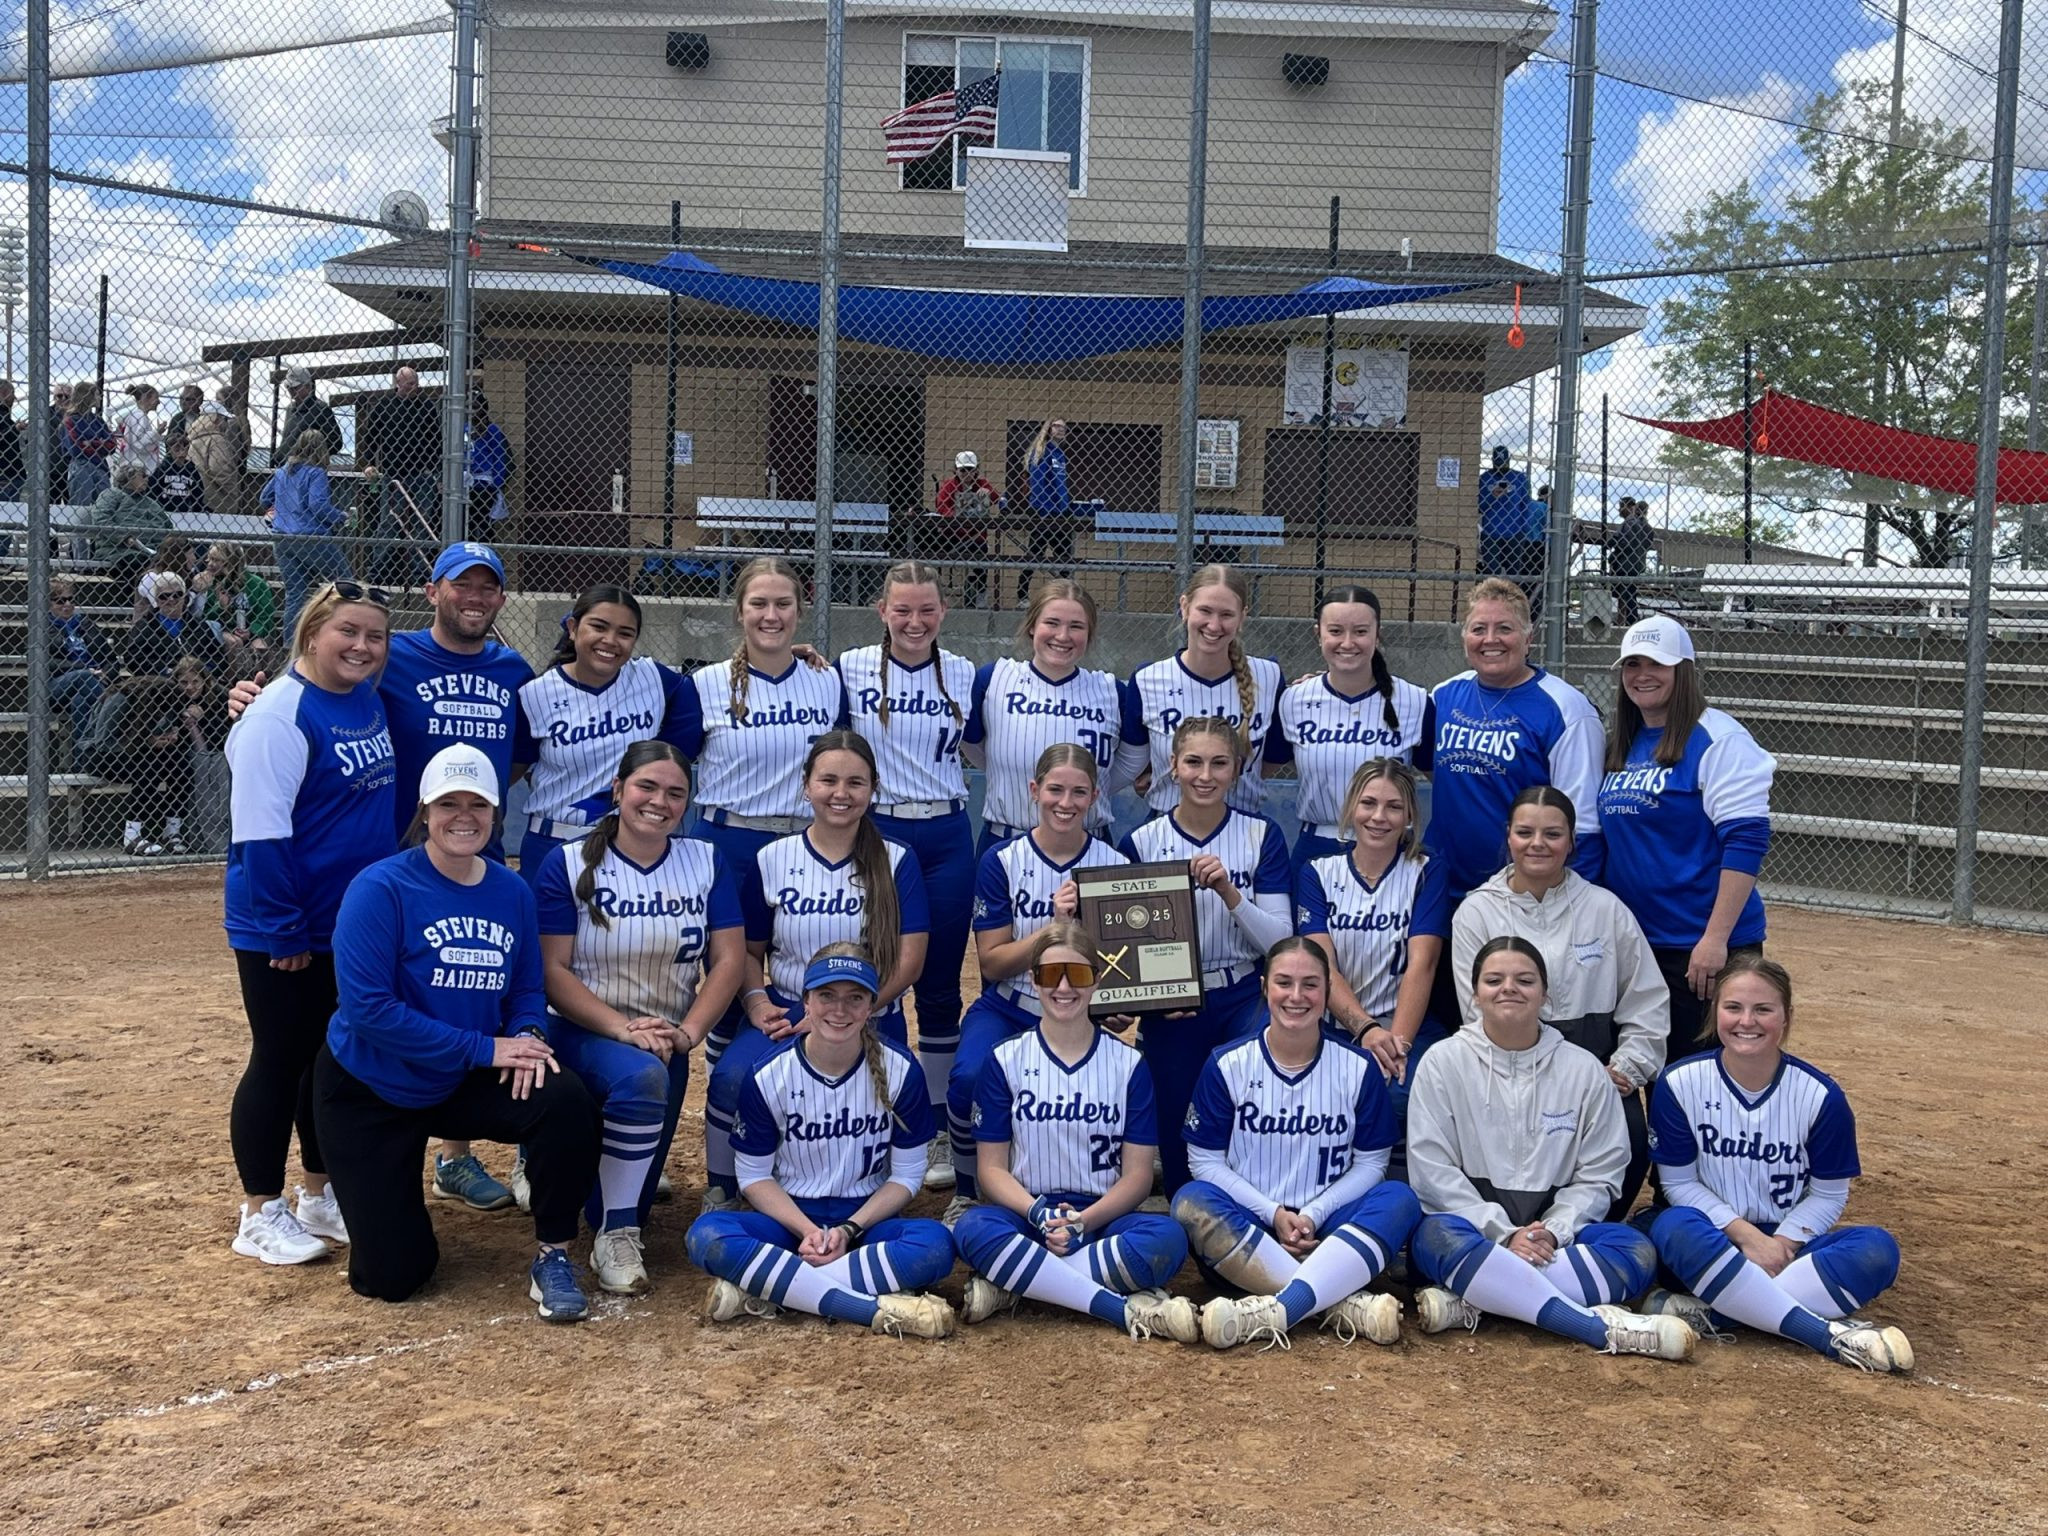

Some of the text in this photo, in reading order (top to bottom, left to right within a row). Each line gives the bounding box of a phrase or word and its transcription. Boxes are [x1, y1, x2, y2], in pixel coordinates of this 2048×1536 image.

[416, 673, 511, 708] STEVENS
[442, 703, 497, 716] SOFTBALL
[1006, 692, 1105, 723] Raiders
[428, 718, 507, 740] RAIDERS
[548, 710, 653, 748] Raiders
[1297, 720, 1402, 748] Raiders
[1436, 722, 1520, 762] STEVENS
[935, 727, 962, 763] 14
[443, 766, 478, 777] STEVENS
[1598, 767, 1674, 794] STEVENS
[1604, 805, 1640, 815] SOFTBALL
[777, 887, 864, 916] Raide
[1111, 880, 1158, 893] STATE
[593, 887, 704, 918] Raiders
[1104, 908, 1171, 925] 20 25
[1326, 901, 1410, 932] Raiders
[423, 916, 514, 953] STEVENS
[448, 950, 498, 964] SOFTBALL
[828, 958, 863, 971] STEVENS
[430, 967, 506, 990] RAIDERS
[1099, 983, 1188, 1002] QUALIFIER
[1015, 1089, 1120, 1125] Raiders
[1237, 1101, 1348, 1136] Raiders
[785, 1107, 890, 1142] Raiders
[861, 1141, 891, 1179] 12
[1317, 1143, 1349, 1186] 15
